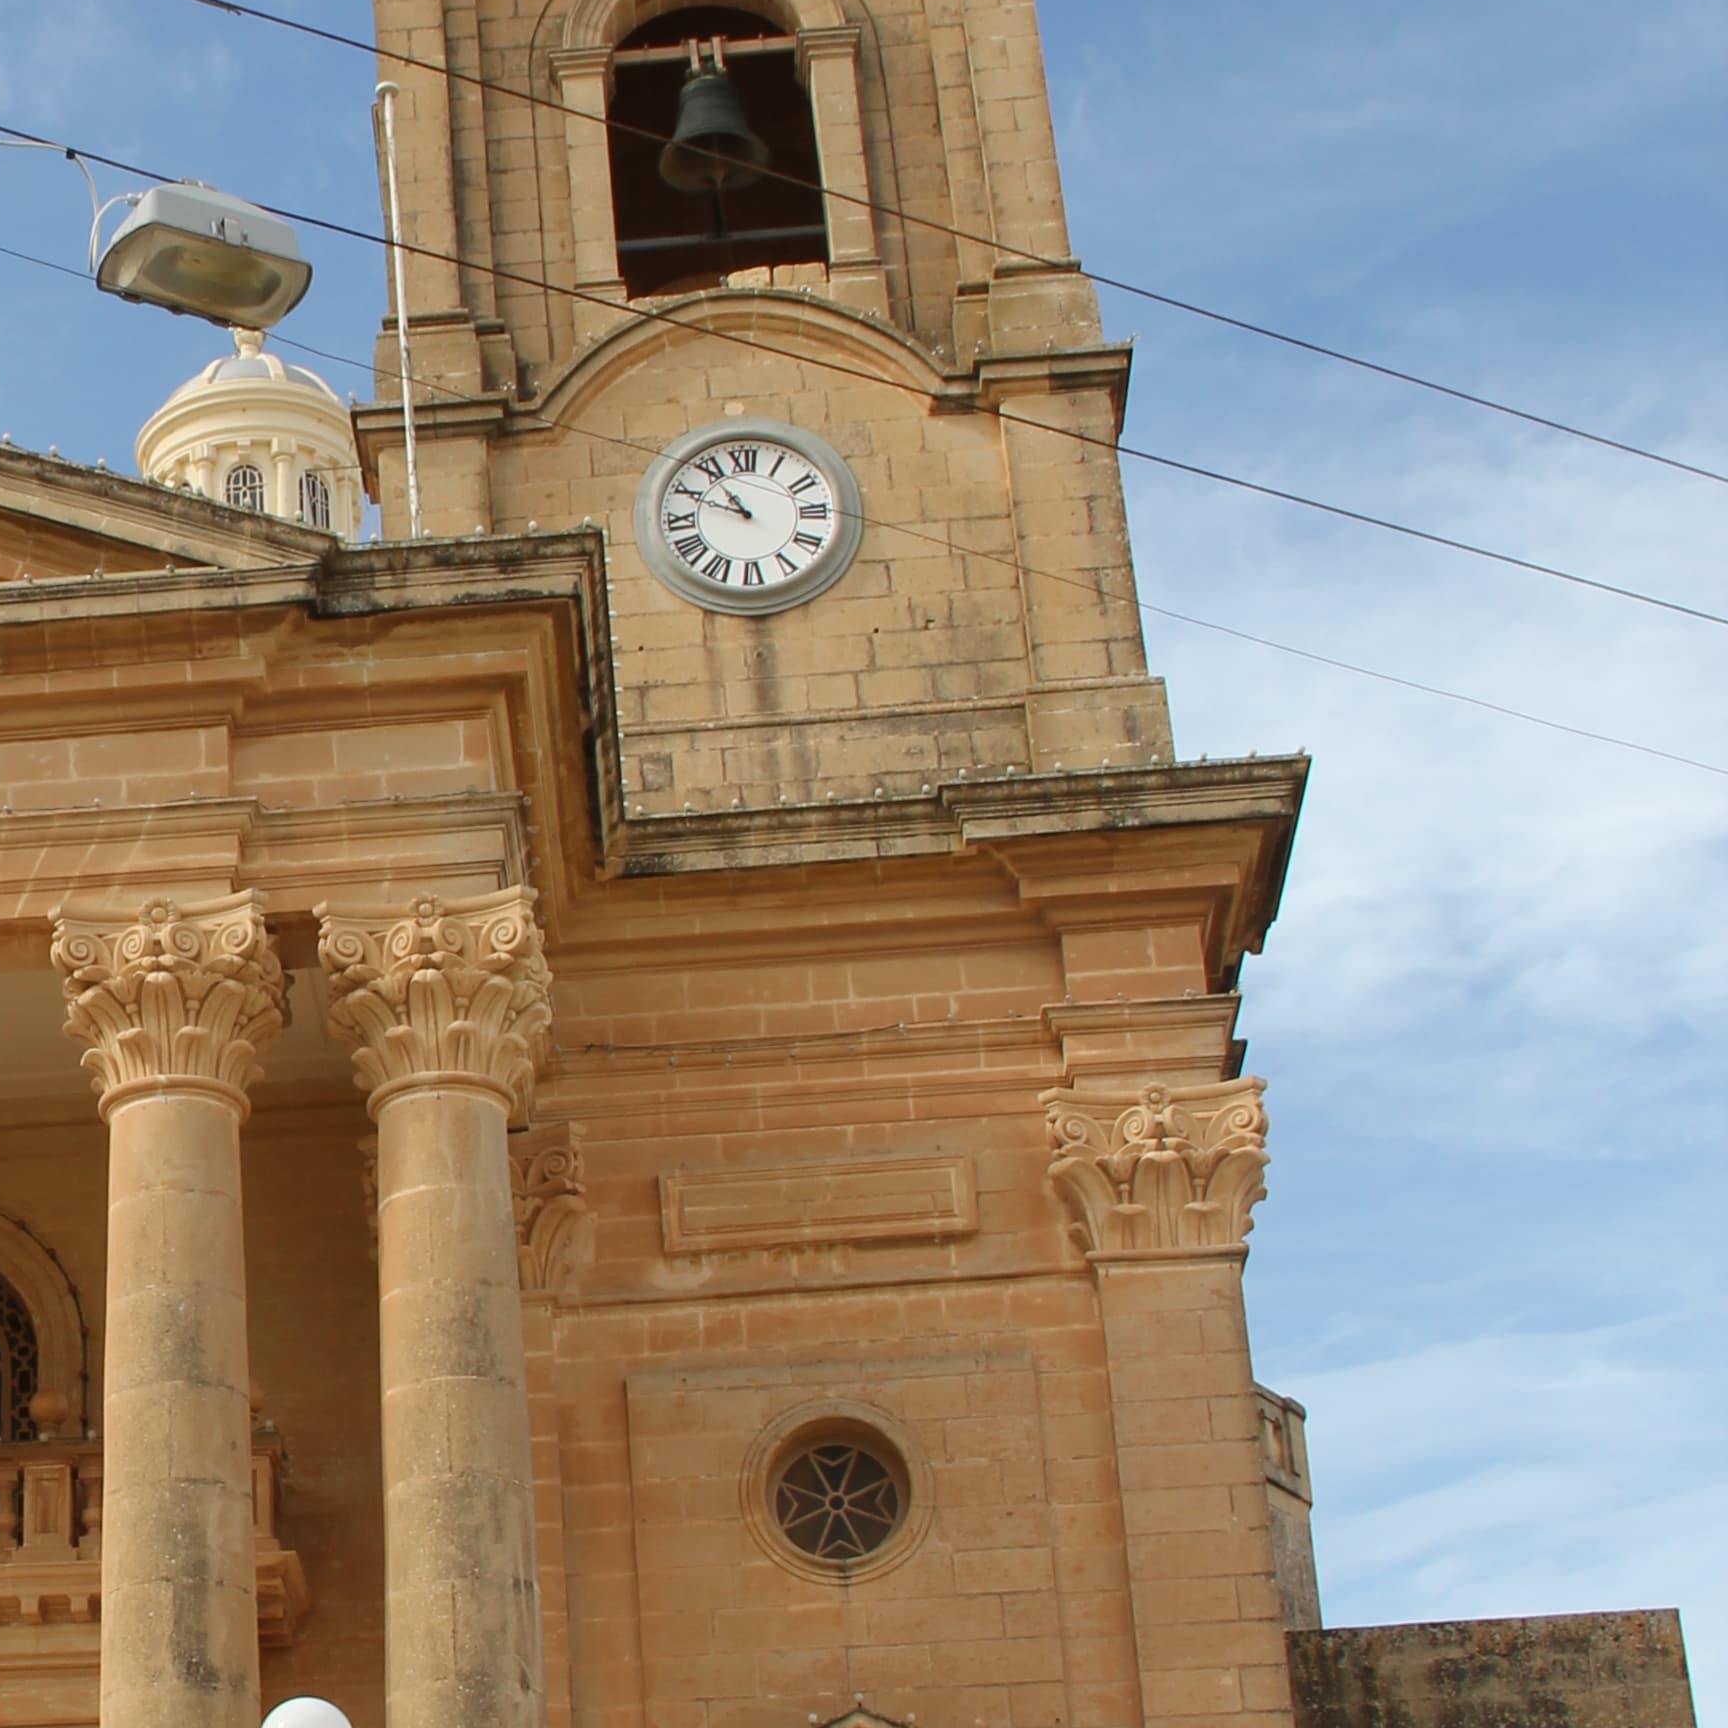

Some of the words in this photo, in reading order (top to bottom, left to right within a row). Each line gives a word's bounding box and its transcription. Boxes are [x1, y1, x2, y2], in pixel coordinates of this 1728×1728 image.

[695, 455, 725, 484] XI
[728, 449, 758, 474] XII
[769, 454, 784, 477] I
[674, 481, 703, 502] X
[788, 473, 818, 495] II
[667, 512, 696, 531] IX
[799, 503, 827, 519] III
[674, 534, 709, 567] VIII
[793, 531, 823, 555] IV
[701, 554, 732, 584] VII
[742, 561, 765, 585] VI
[775, 552, 799, 577] V
